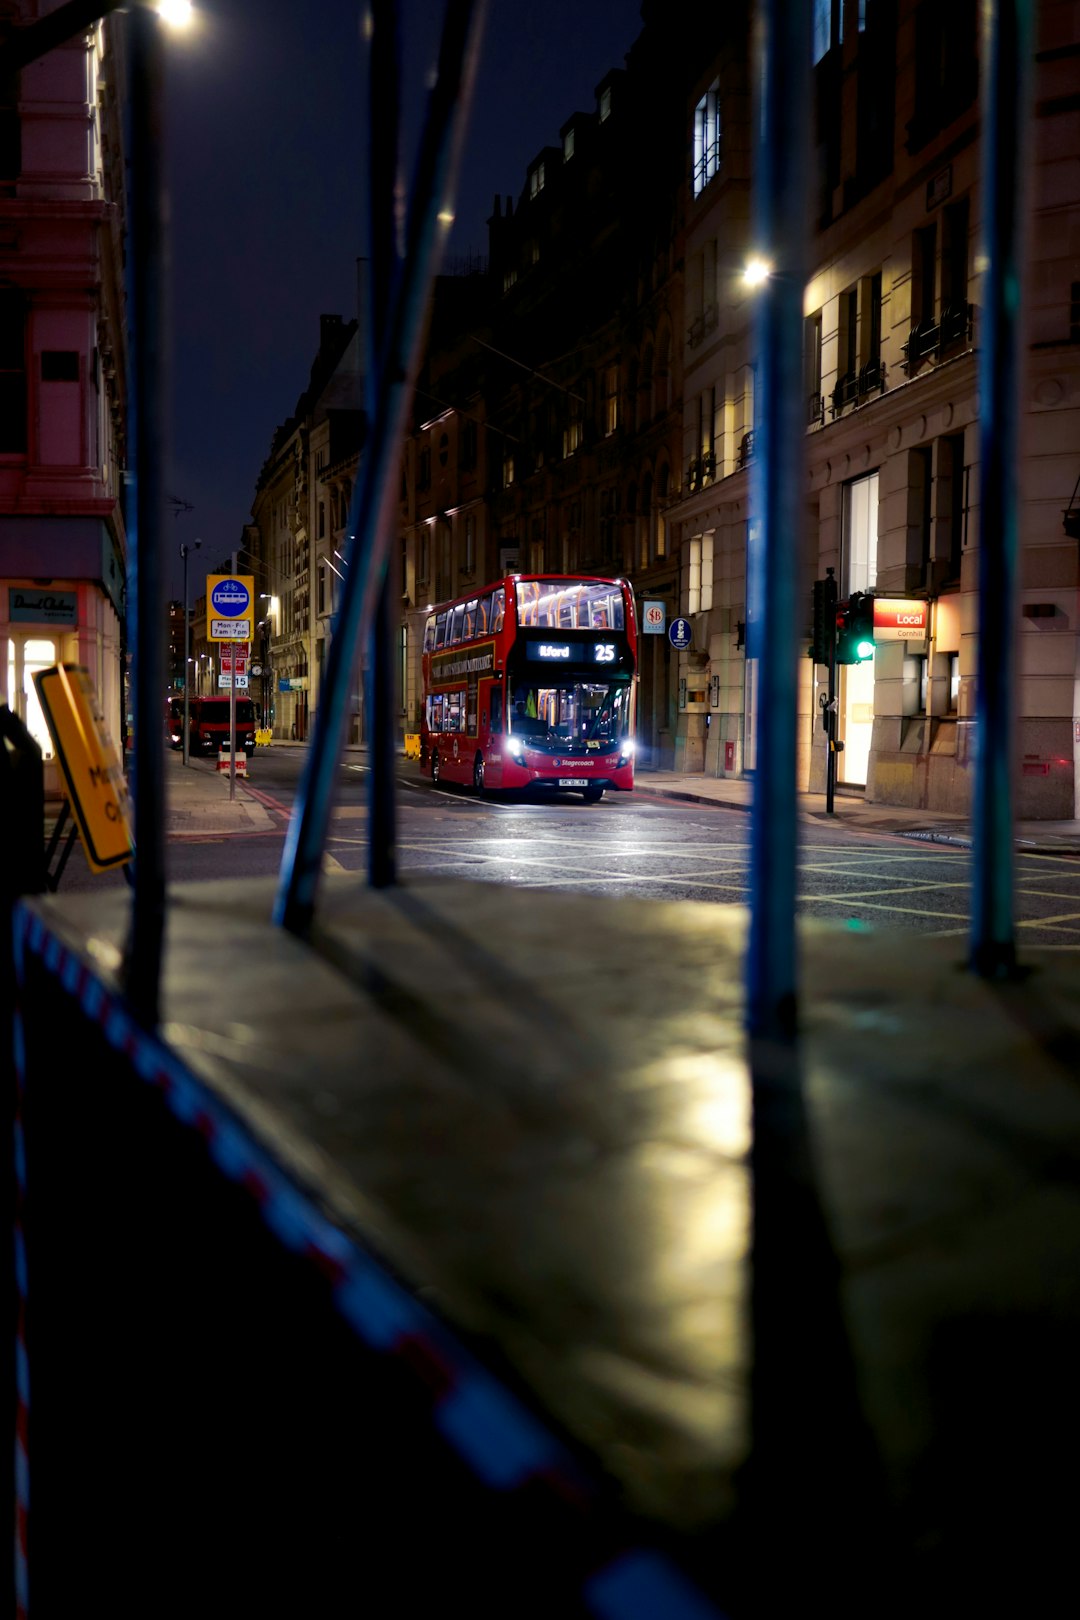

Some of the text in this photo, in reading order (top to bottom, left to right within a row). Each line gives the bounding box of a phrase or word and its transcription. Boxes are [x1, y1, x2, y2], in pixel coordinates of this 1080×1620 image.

[896, 614, 923, 625] Local
[539, 645, 570, 658] Ilford
[595, 644, 615, 661] 25
[235, 678, 246, 686] 15
[561, 759, 594, 767] Stagecoach
